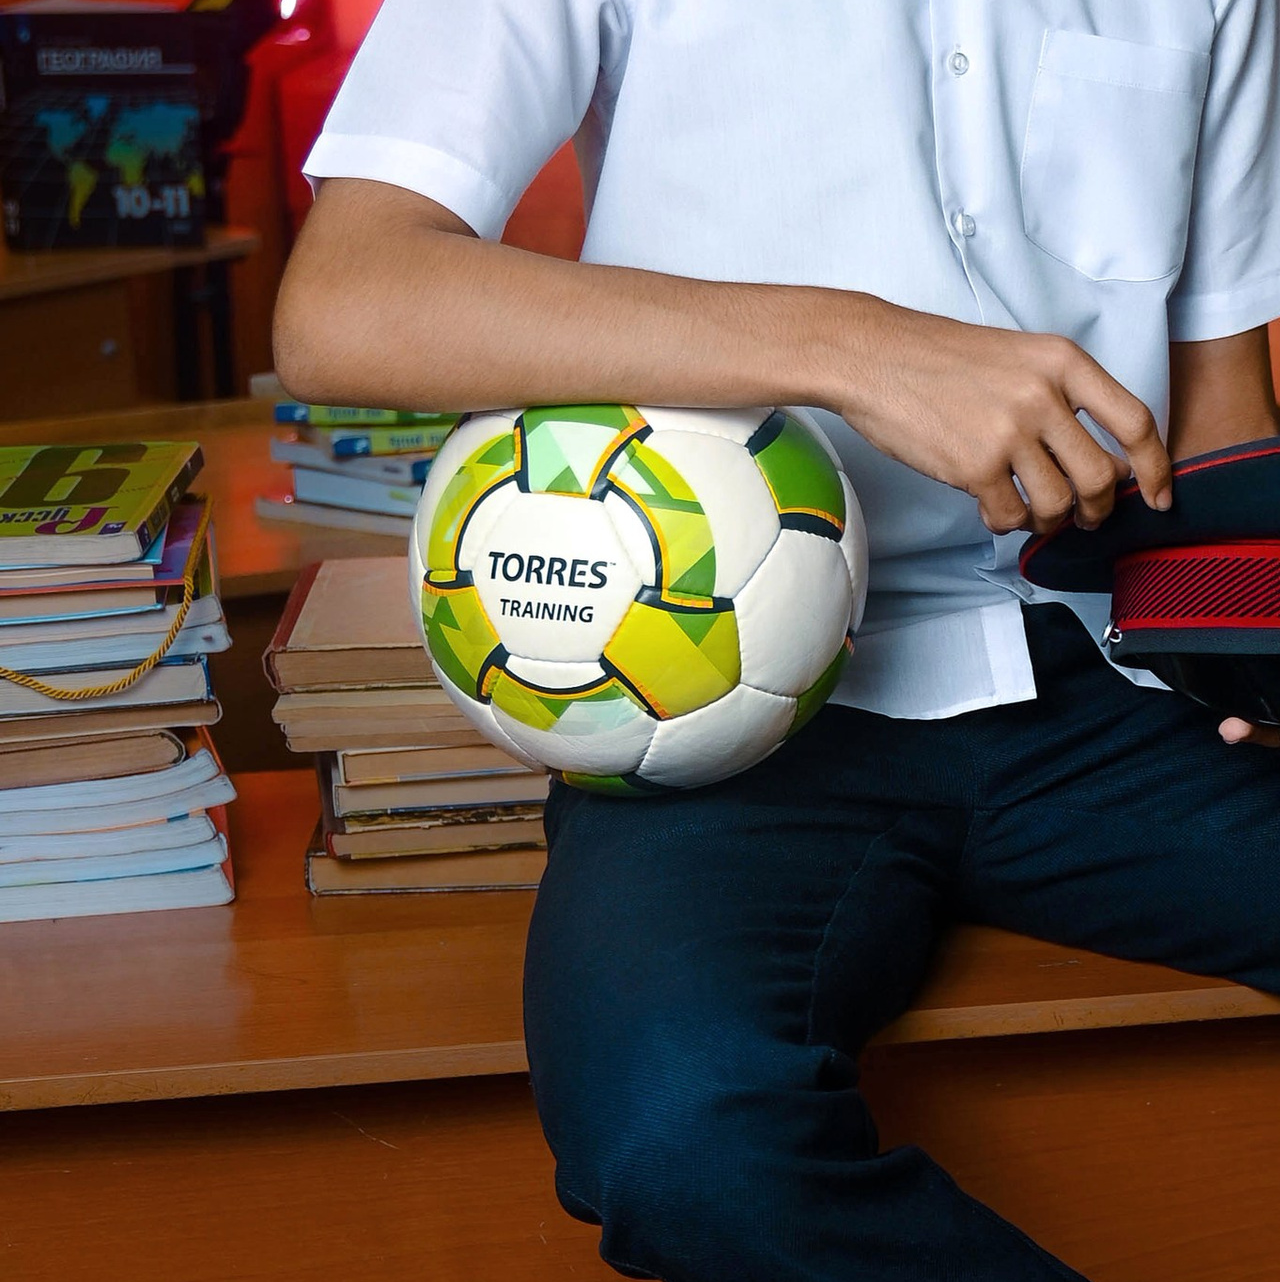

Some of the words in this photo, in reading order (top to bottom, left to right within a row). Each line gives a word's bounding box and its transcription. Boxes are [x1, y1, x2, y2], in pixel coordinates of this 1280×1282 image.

[113, 186, 190, 218] 10-11
[488, 551, 608, 589] TORRES
[500, 598, 594, 623] TRAINING
